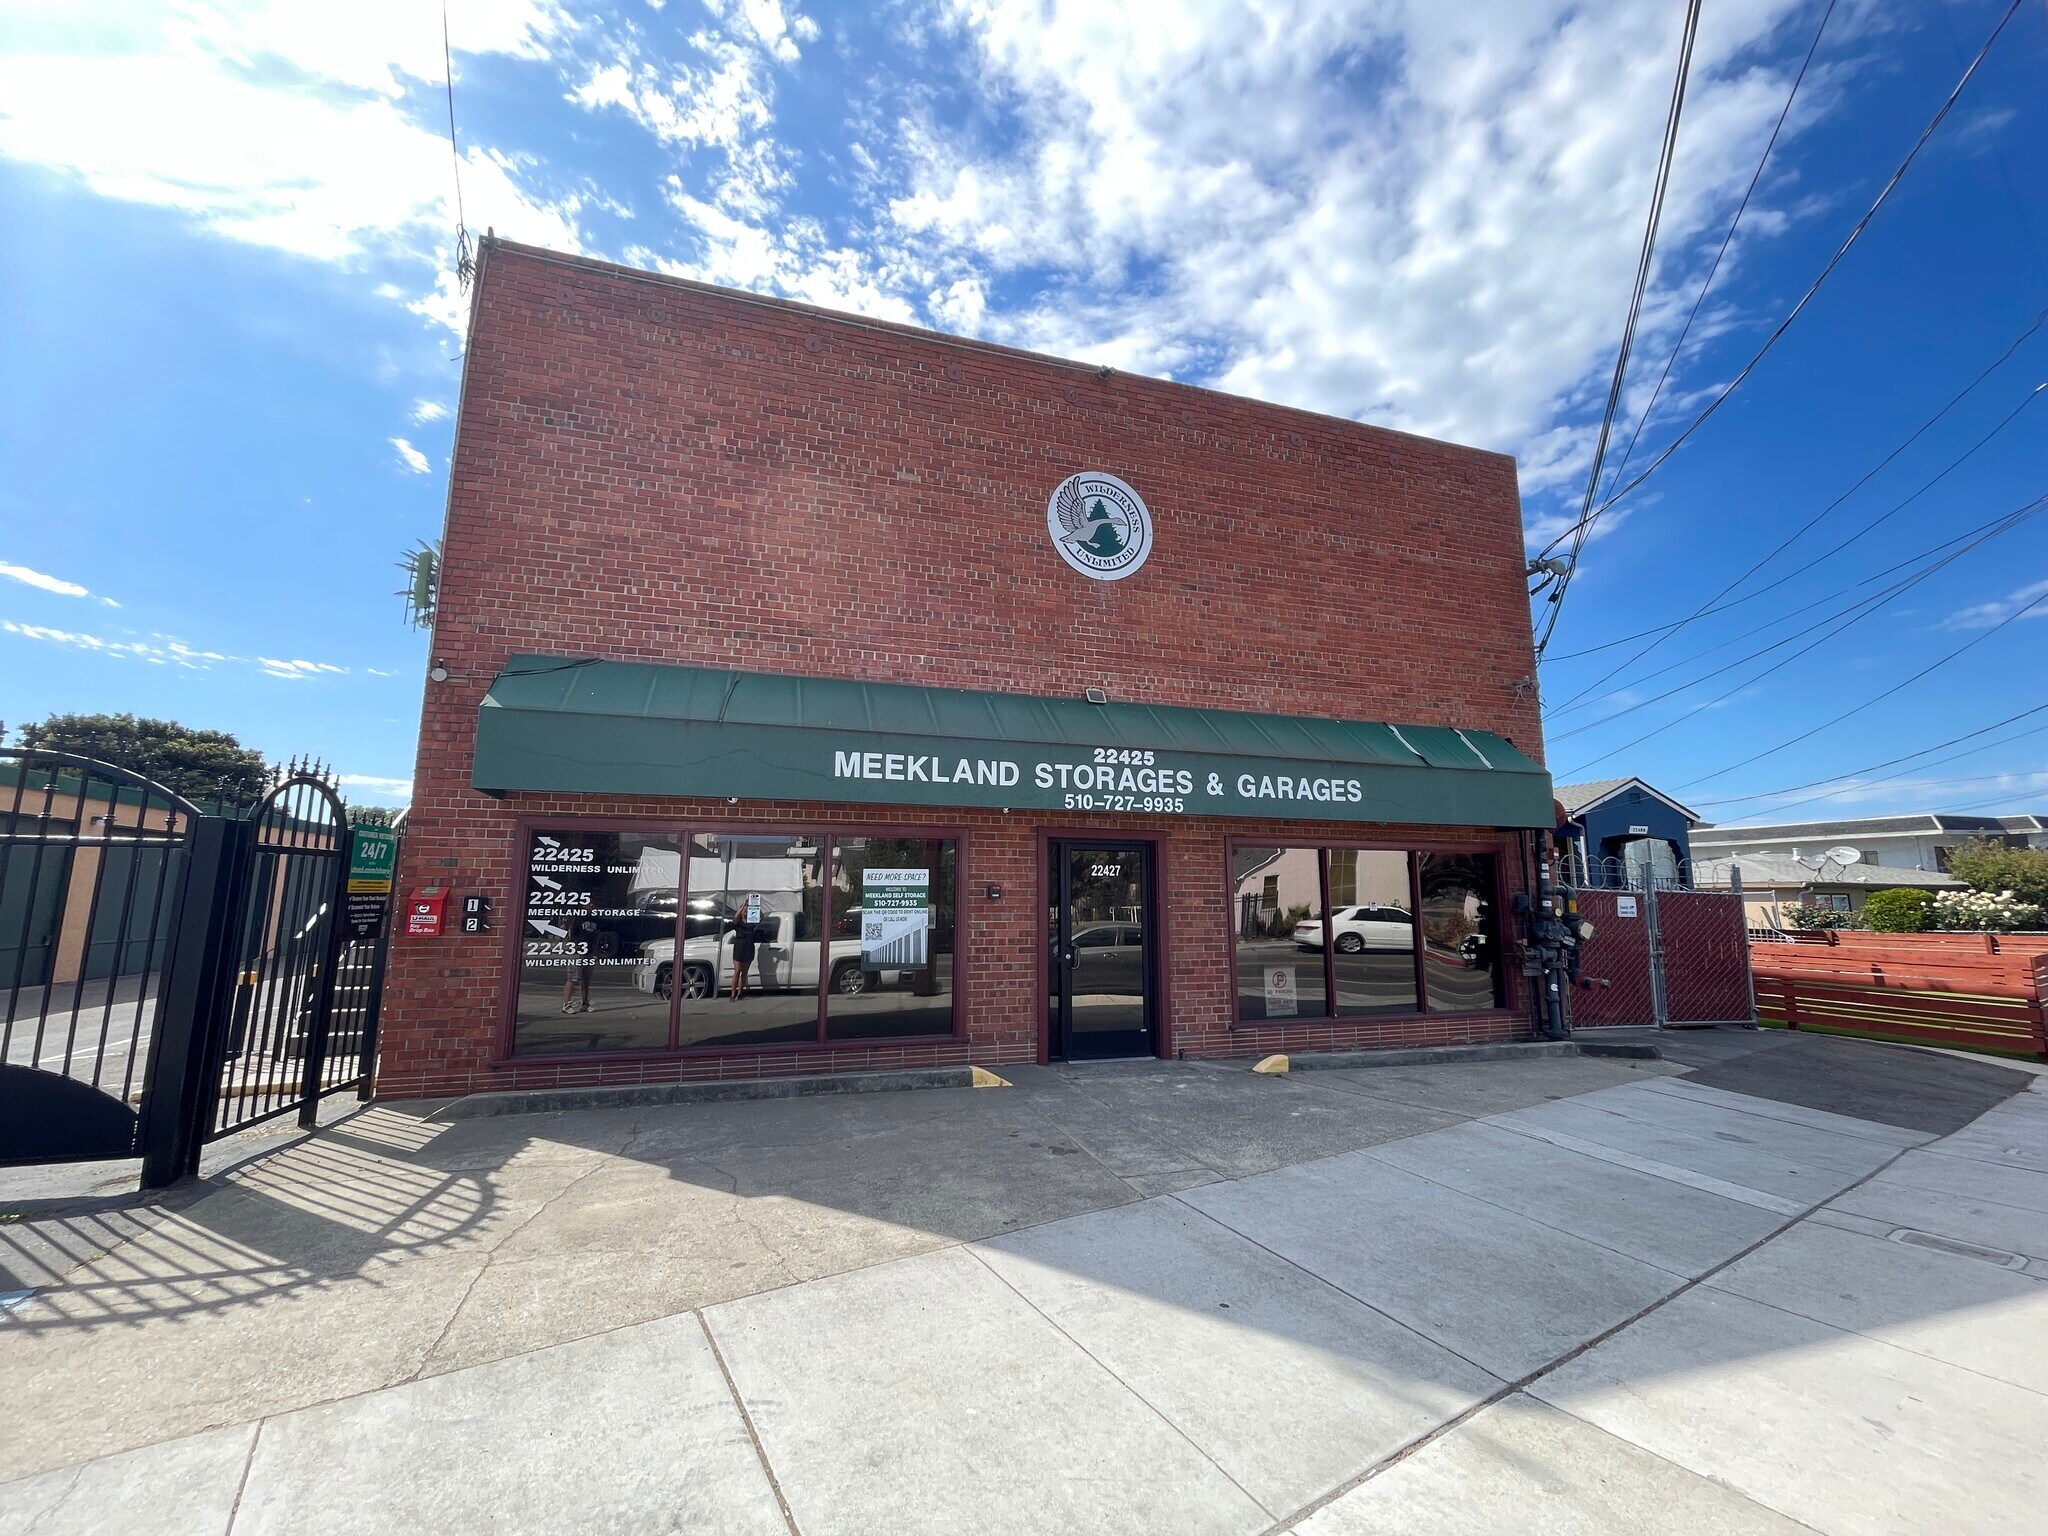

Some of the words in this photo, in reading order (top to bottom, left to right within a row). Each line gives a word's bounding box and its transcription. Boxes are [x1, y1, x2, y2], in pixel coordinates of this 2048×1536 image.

[1085, 485, 1140, 533] WILDERNESS
[1076, 547, 1135, 568] UNLIMITED
[1093, 748, 1155, 766] 22425
[834, 750, 1020, 787] MEEKLAND
[1034, 763, 1194, 794] STORAGES
[1206, 772, 1224, 796] &
[1237, 774, 1363, 803] GARAGES
[1064, 793, 1184, 813] 510-727-9935
[361, 842, 387, 859] 24/7
[532, 847, 594, 862] 22425
[531, 864, 601, 873] WILDERNESS
[1091, 864, 1121, 877] 22427
[866, 872, 884, 880] NEED
[885, 872, 902, 880] MORE
[904, 872, 926, 880] SPACE?
[470, 900, 476, 910] 1
[529, 891, 592, 905] 22425
[528, 908, 588, 916] MEEKLAND
[591, 909, 640, 917] STORAGE
[468, 920, 476, 930] 2
[526, 941, 589, 956] 22433
[525, 958, 596, 967] WILDERNESS
[599, 957, 657, 966] UNLIMITED
